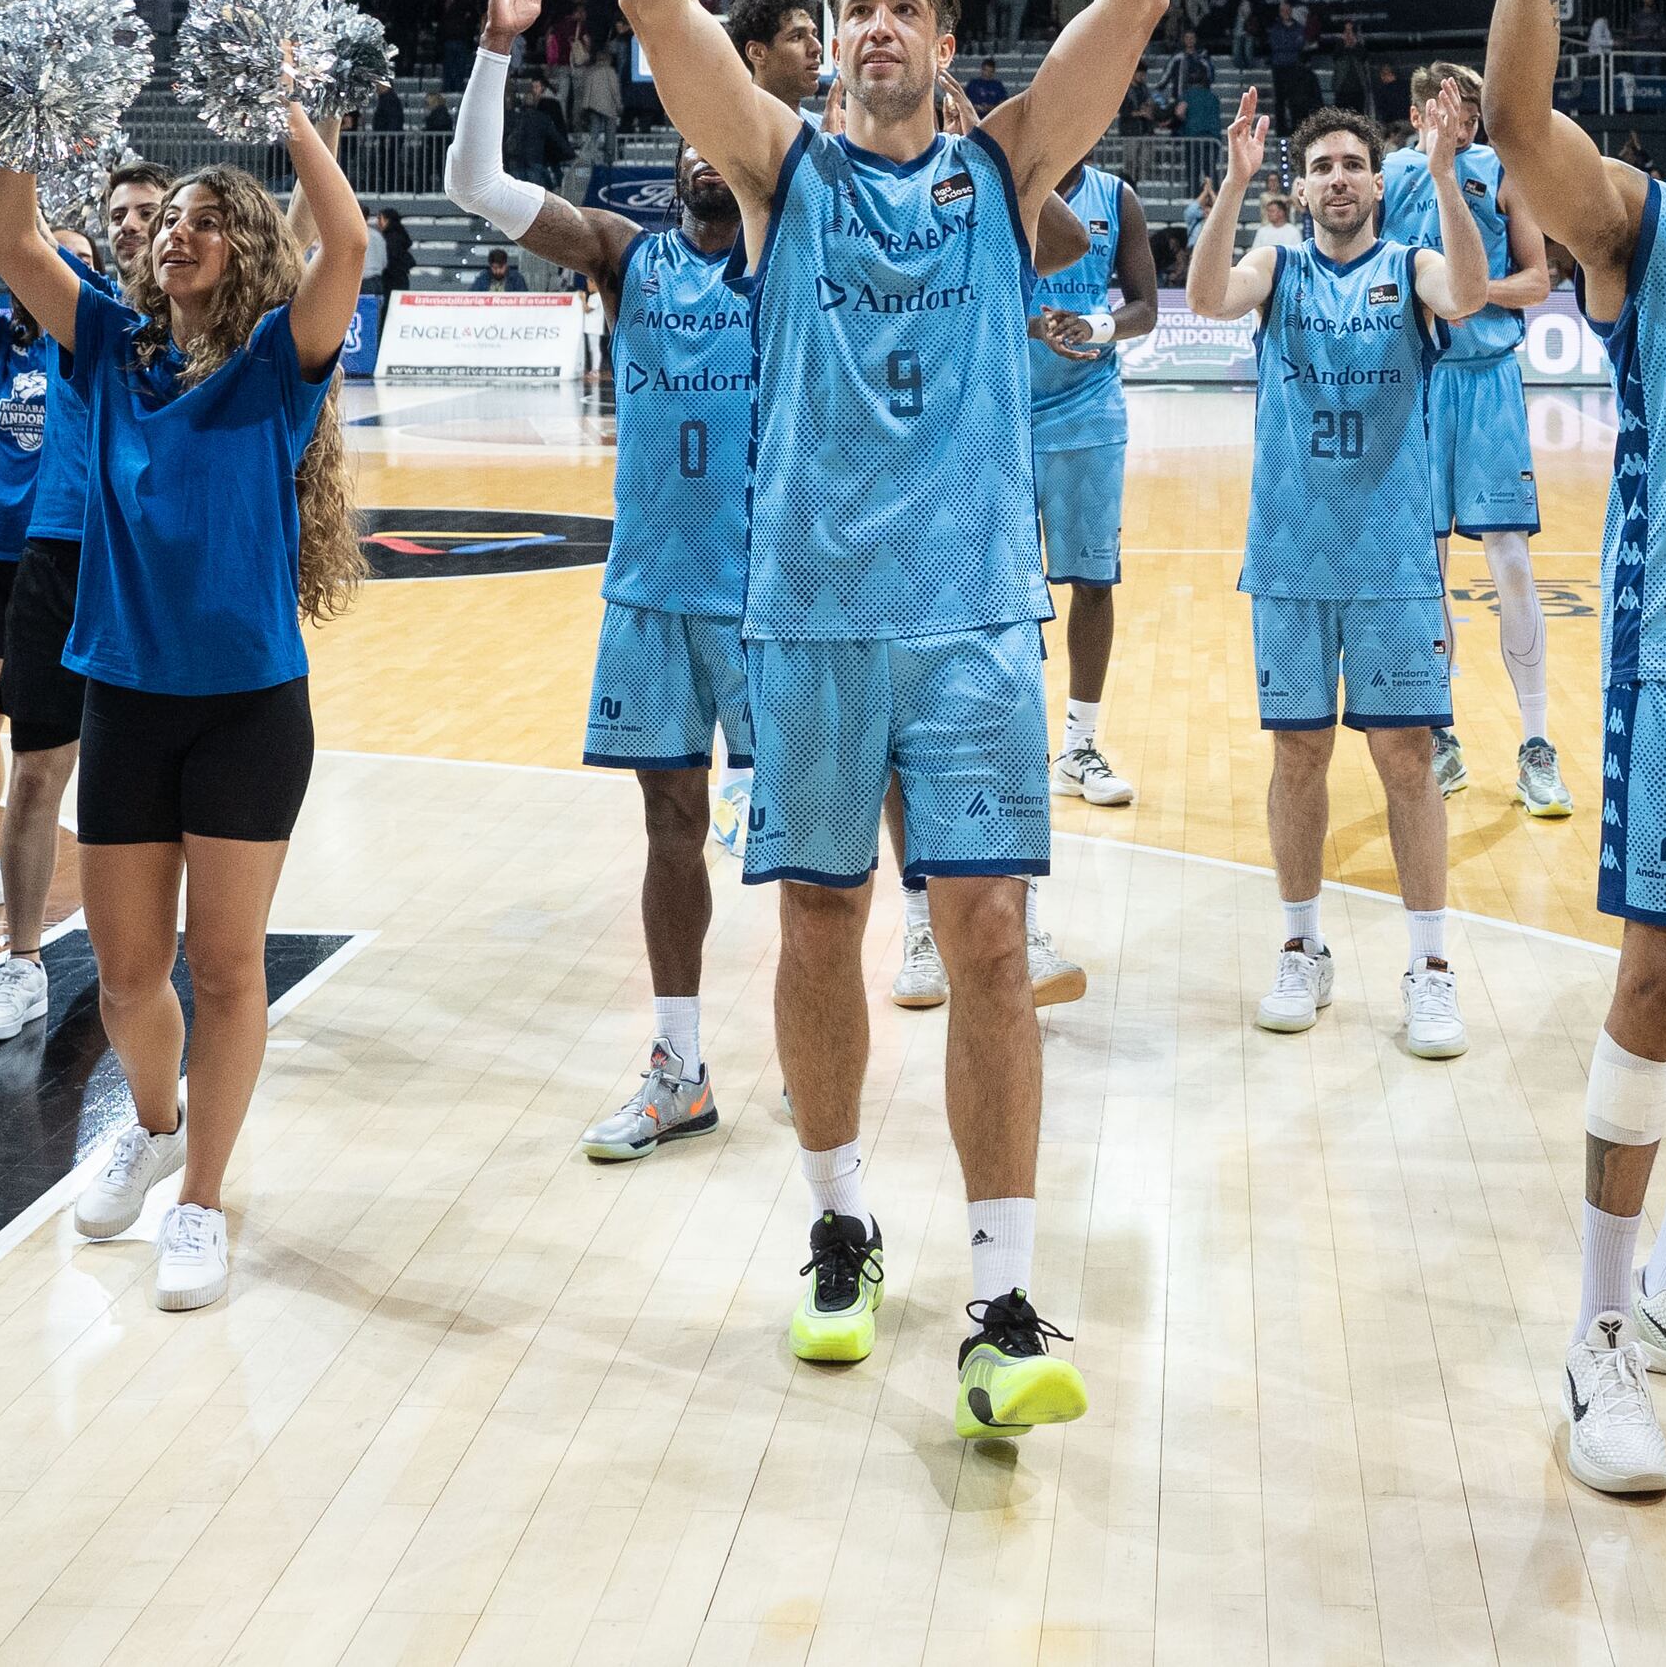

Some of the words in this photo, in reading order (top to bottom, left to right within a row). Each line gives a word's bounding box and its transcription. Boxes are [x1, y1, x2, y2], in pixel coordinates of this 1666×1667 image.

[934, 186, 953, 198] liga
[852, 285, 976, 314] Andorr
[400, 324, 561, 341] ENGEL&VÖLKERS
[1299, 314, 1403, 335] MORABANC
[1155, 328, 1252, 348] ANDORRA
[887, 350, 923, 417] 9
[1303, 364, 1402, 385] Andorra
[1310, 410, 1364, 460] 20
[680, 420, 707, 479] 0
[1392, 669, 1429, 679] andorra
[1392, 678, 1432, 688] telecom
[998, 793, 1044, 805] andorra
[997, 806, 1045, 819] telecom
